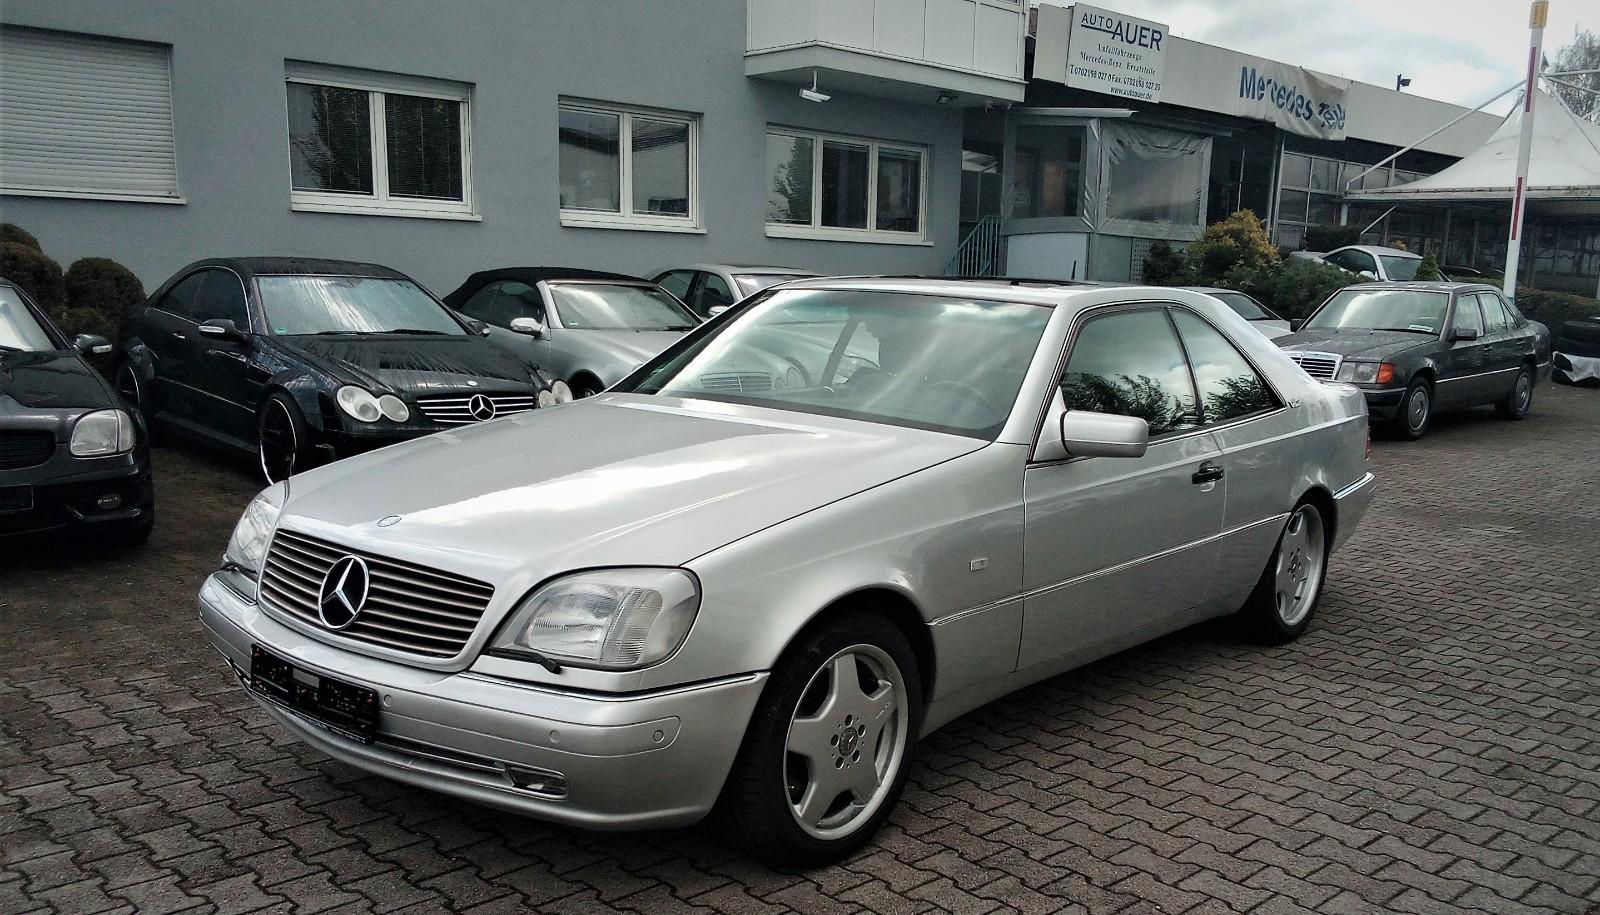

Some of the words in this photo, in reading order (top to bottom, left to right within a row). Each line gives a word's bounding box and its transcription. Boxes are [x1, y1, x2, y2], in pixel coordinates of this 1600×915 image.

[1081, 12, 1113, 29] AUTO
[1112, 20, 1163, 51] AUER
[1239, 66, 1313, 121] Mercedes
